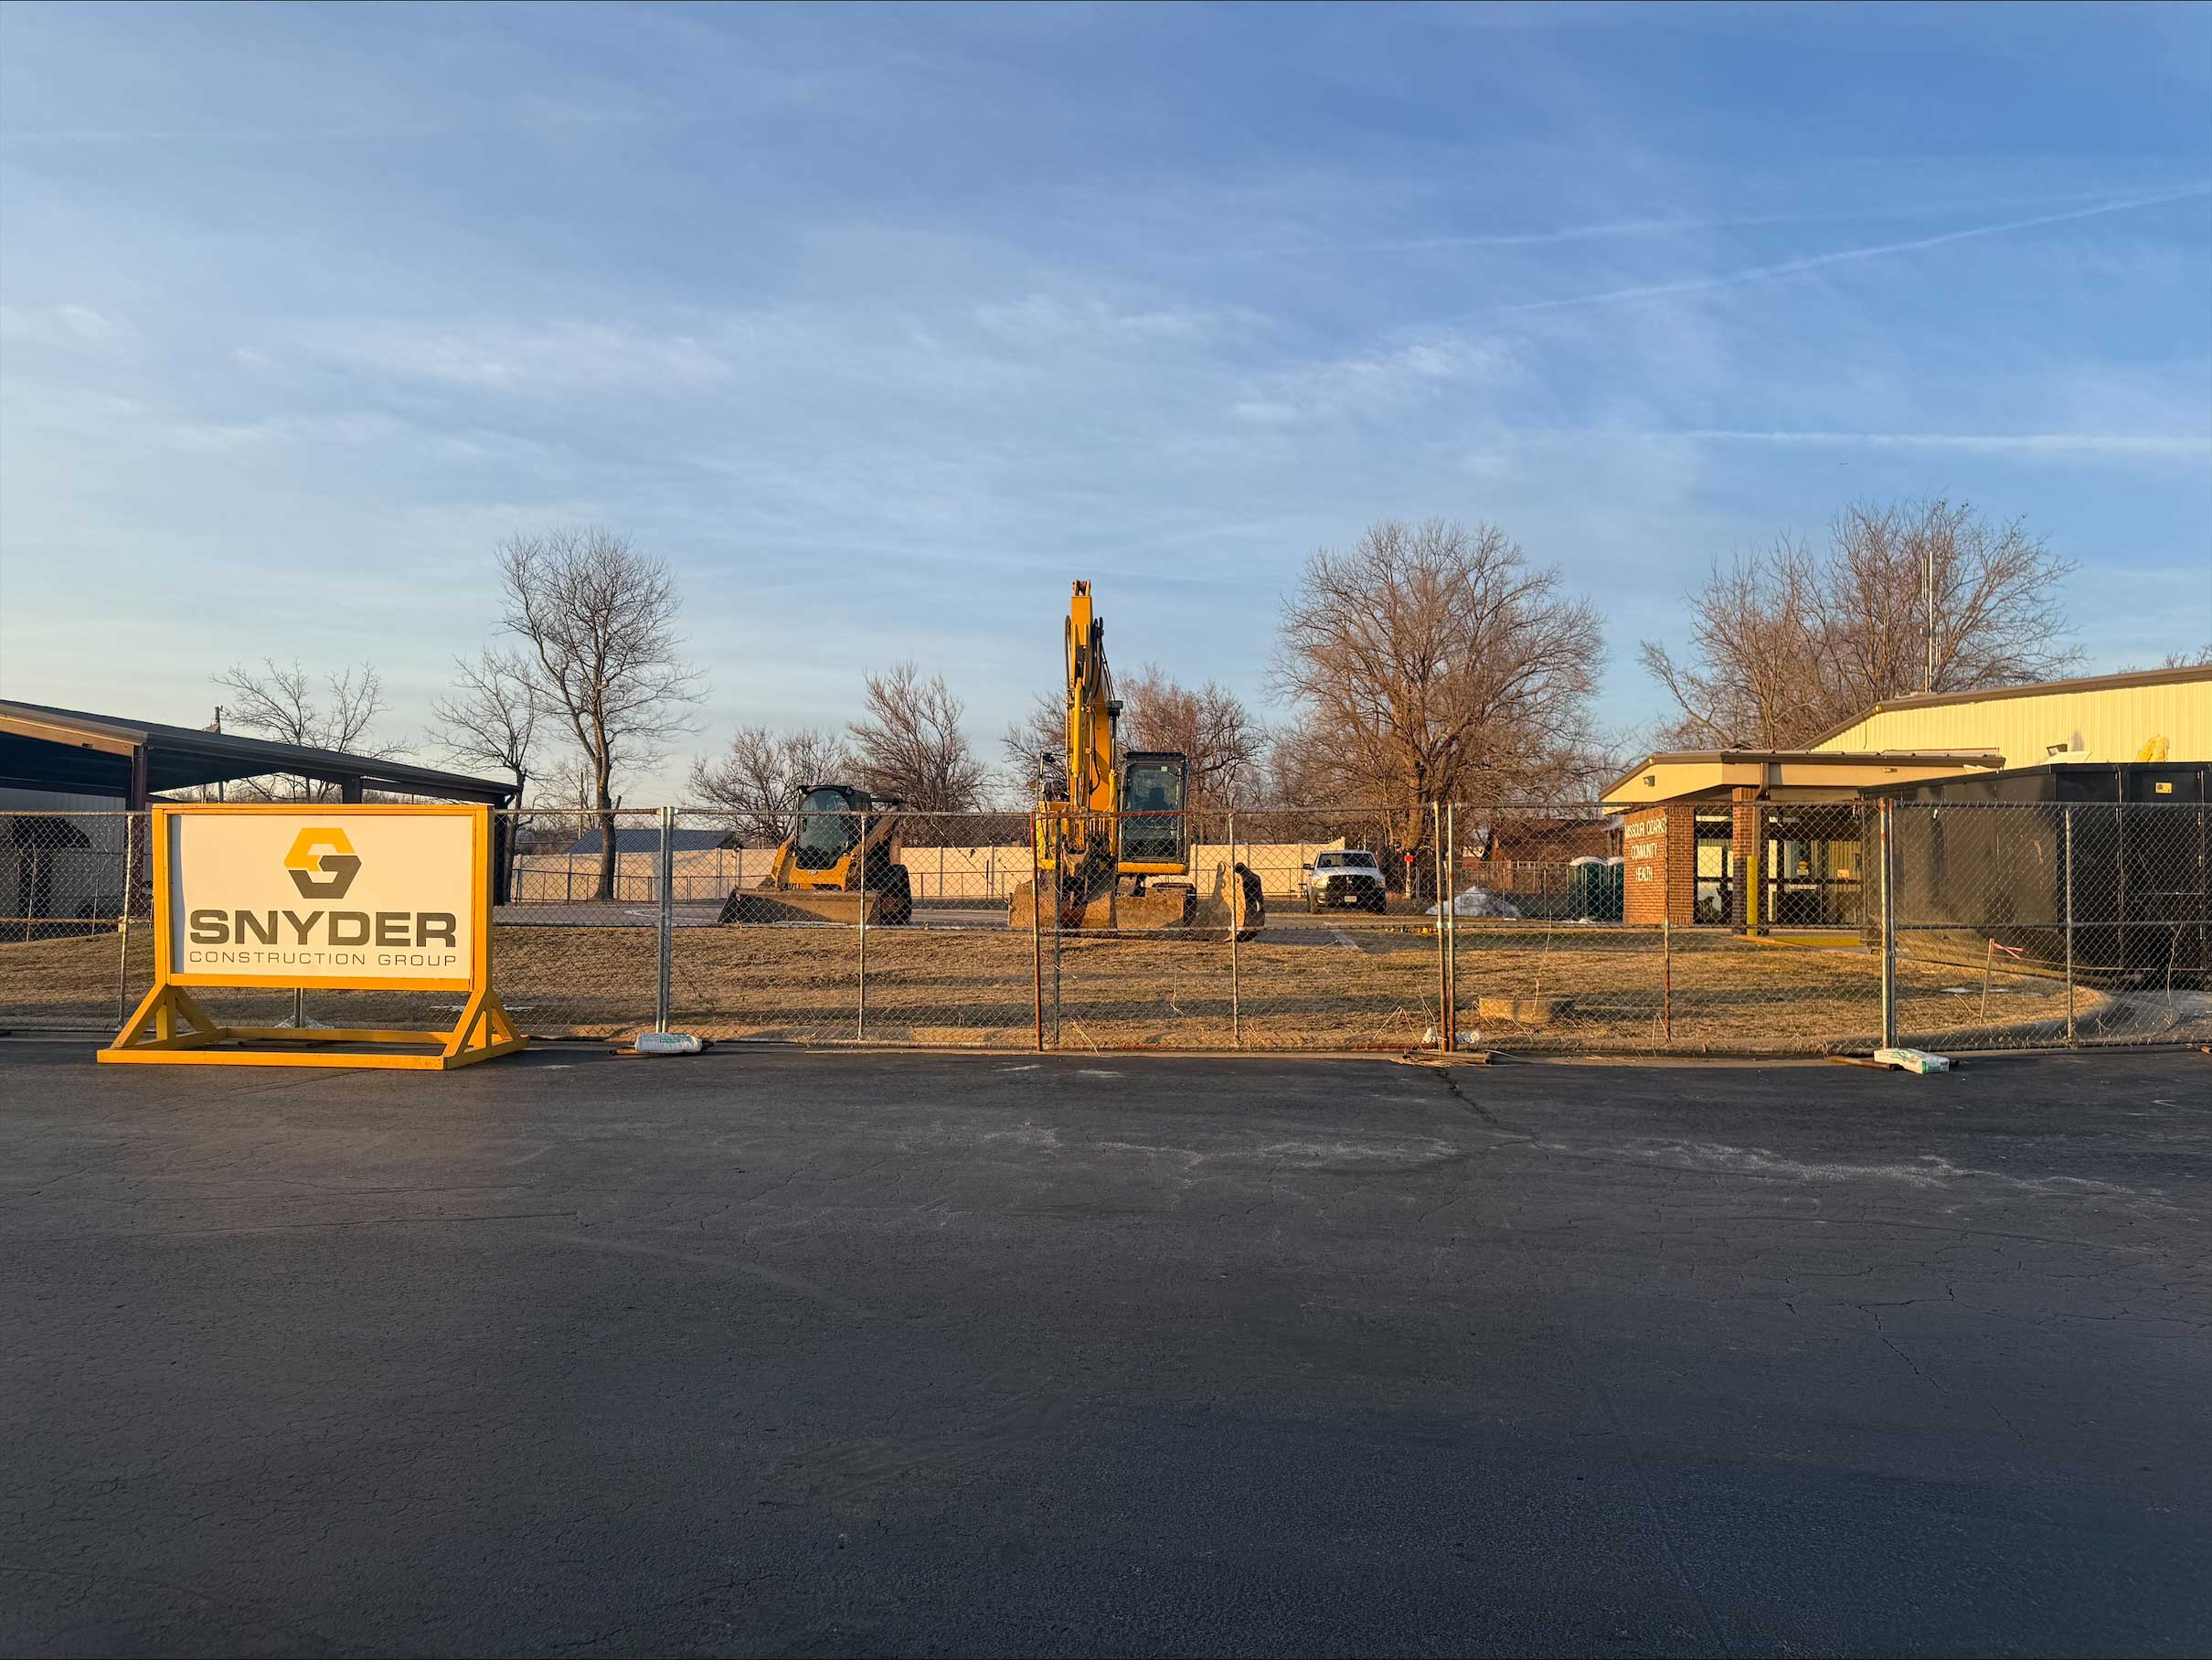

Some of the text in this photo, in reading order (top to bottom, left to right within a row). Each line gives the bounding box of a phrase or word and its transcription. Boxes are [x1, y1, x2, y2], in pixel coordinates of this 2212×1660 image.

[1632, 843, 1657, 859] COMMUNITY
[1635, 866, 1654, 882] HEALTH
[189, 910, 456, 948] SNYDER
[189, 951, 456, 966] CONSTRUCTION GROUP
